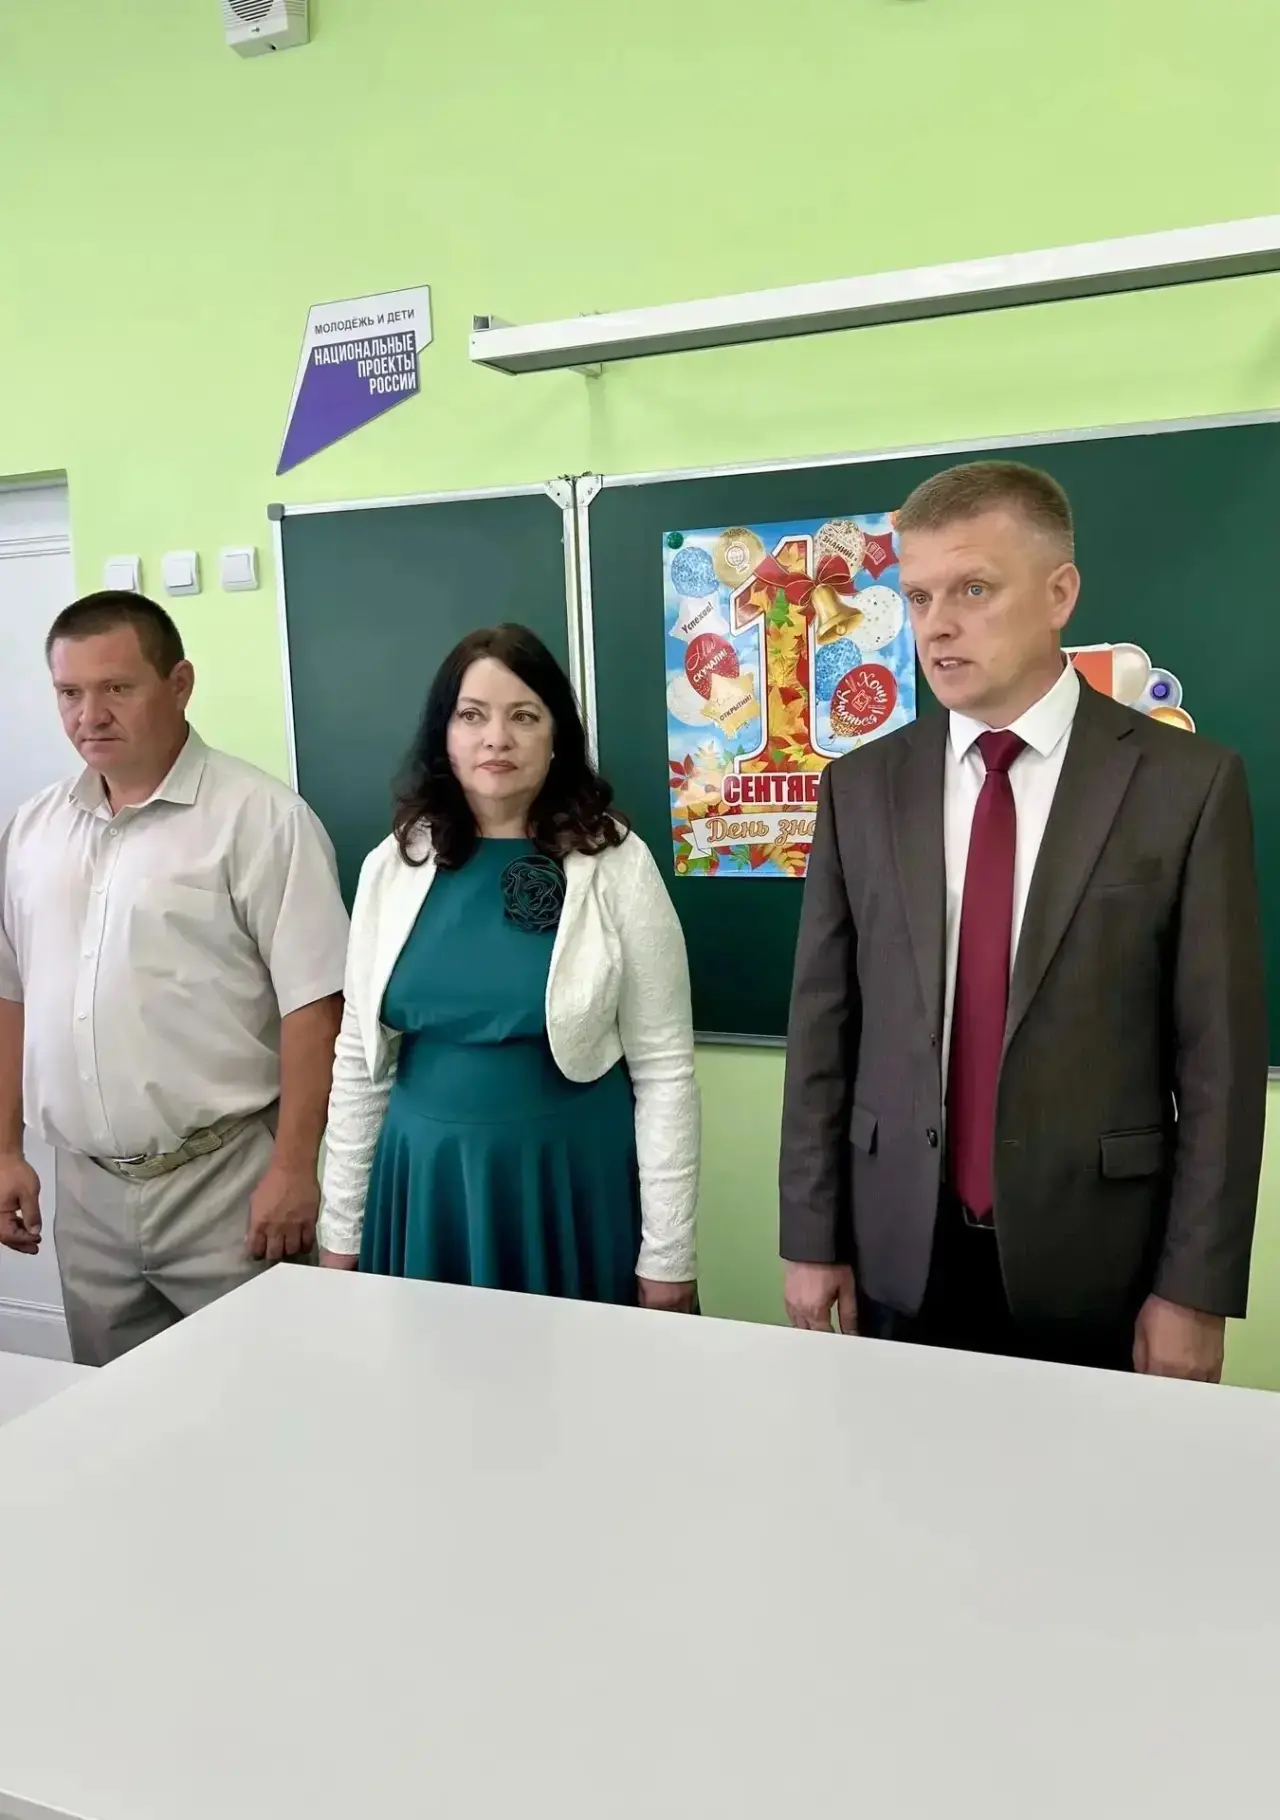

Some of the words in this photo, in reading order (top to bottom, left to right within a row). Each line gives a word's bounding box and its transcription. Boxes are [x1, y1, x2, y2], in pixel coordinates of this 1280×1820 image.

[377, 313, 385, 325] И
[387, 309, 415, 325] ДЕТИ
[314, 333, 414, 366] НАЦИОНАЛЬНЫЕ
[357, 352, 415, 378] ПРОЕКТЫ
[369, 371, 417, 395] РОССИИ
[723, 774, 820, 804] СЕНТЯБ
[705, 817, 770, 843] День
